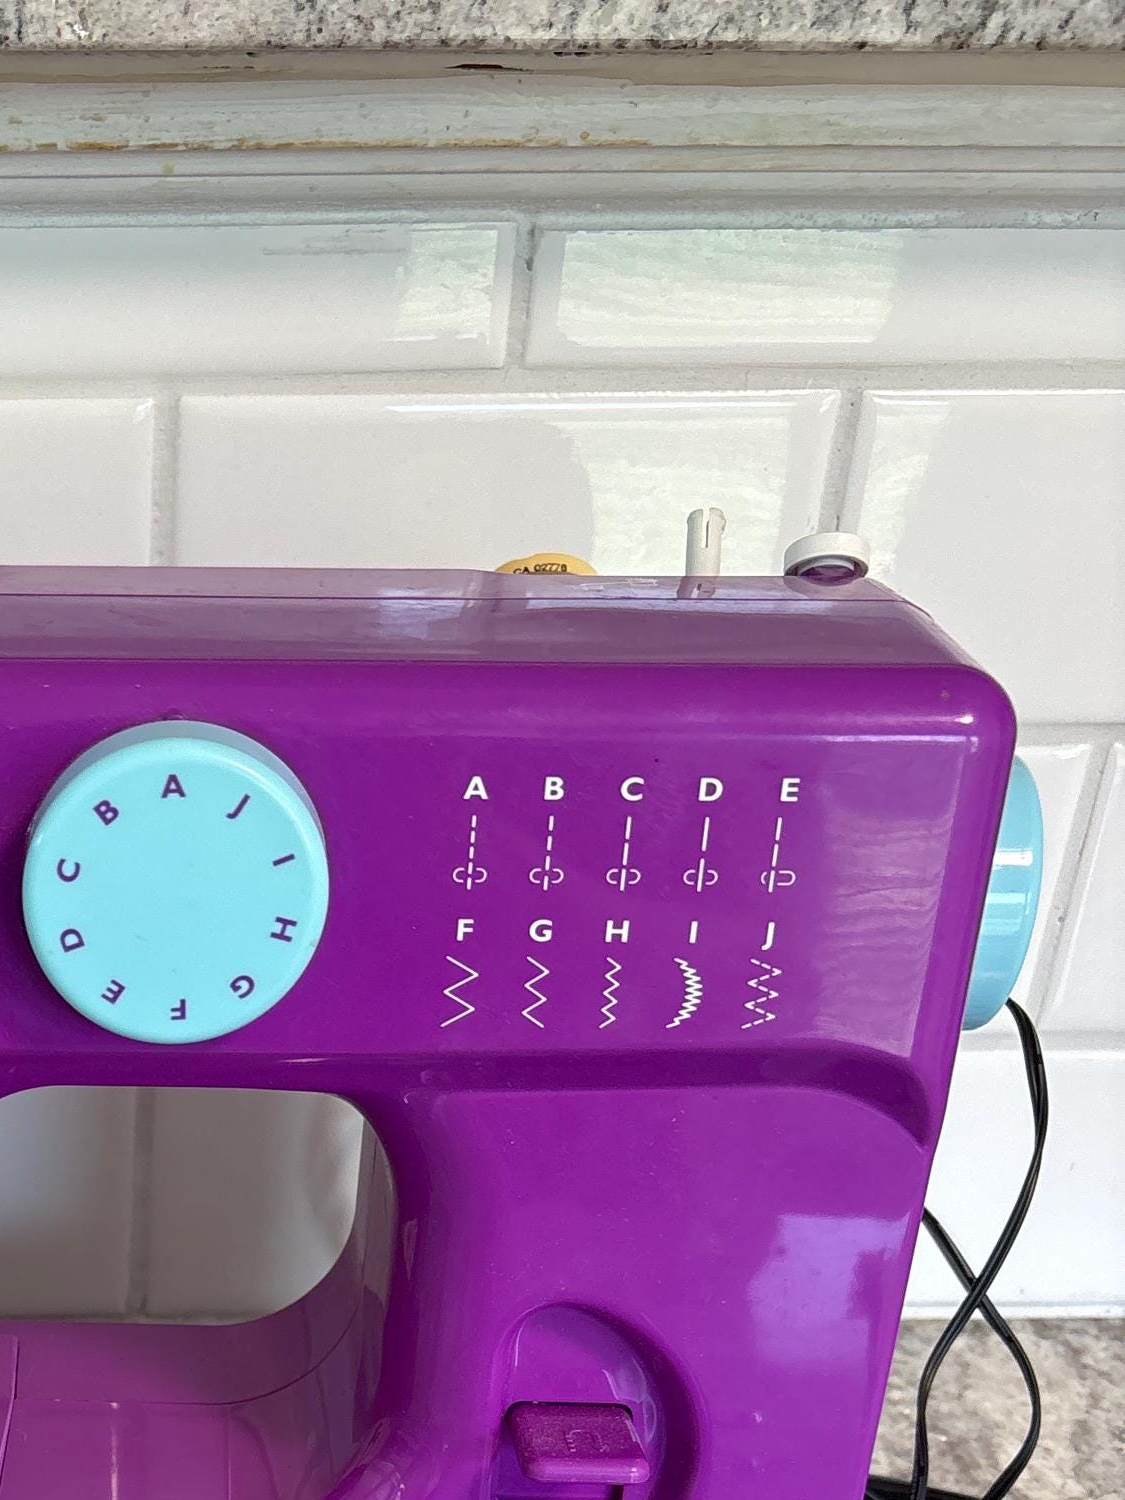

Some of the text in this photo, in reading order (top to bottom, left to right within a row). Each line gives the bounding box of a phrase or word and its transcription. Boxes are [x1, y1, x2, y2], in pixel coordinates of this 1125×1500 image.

[463, 775, 801, 802] A B C D E
[56, 773, 298, 1021] A B C D E F G H I J
[456, 918, 776, 951] F G H I J
